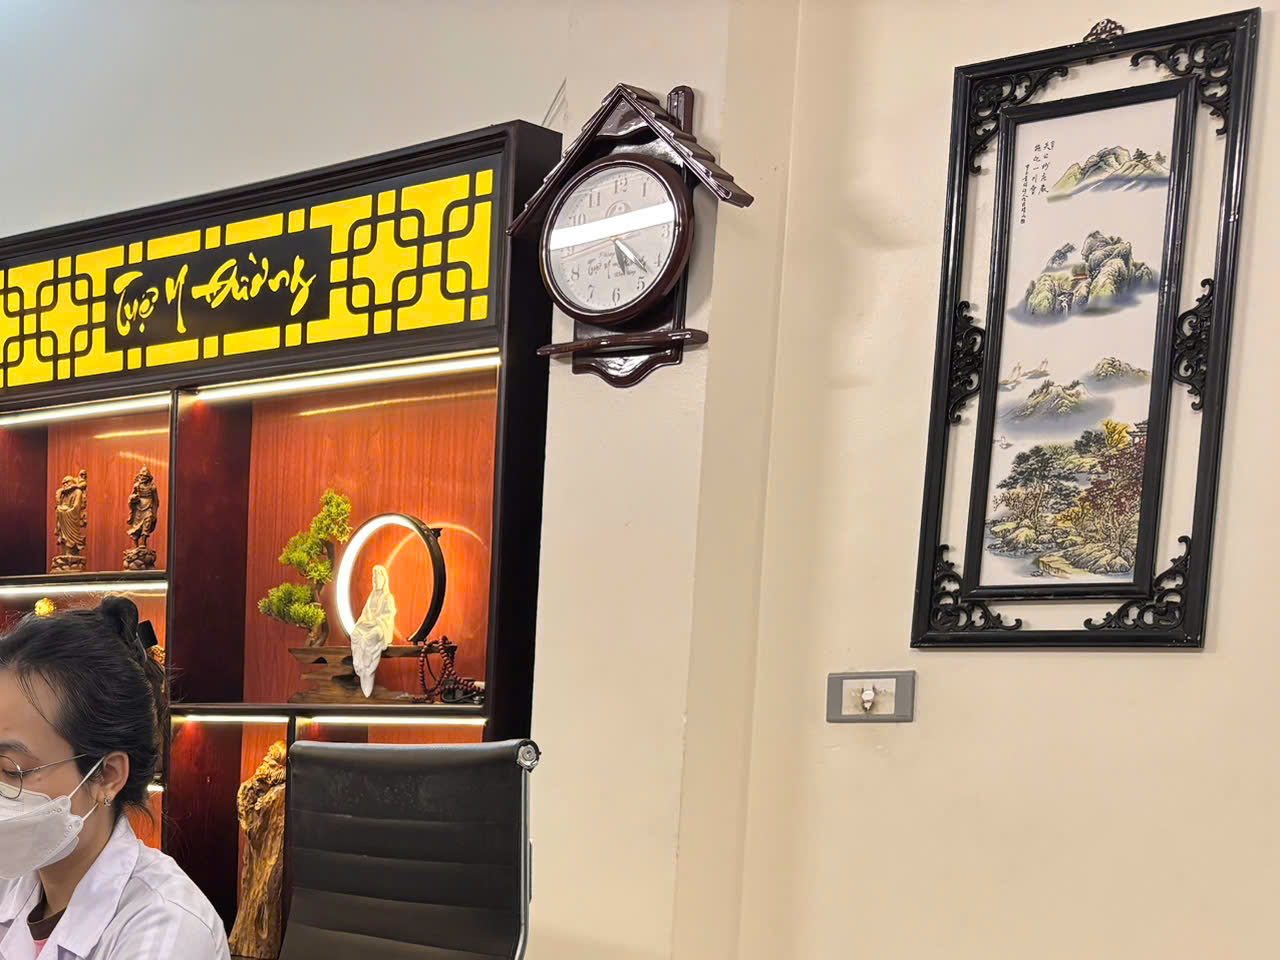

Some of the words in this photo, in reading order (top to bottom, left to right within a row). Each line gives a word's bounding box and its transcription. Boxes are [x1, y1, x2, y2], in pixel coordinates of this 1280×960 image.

[614, 177, 629, 194] 12
[640, 181, 648, 197] 1
[588, 191, 601, 209] 11
[653, 252, 662, 268] 4
[570, 266, 580, 281] 8
[636, 276, 646, 291] 5
[588, 284, 595, 301] 7
[611, 287, 621, 304] 6
